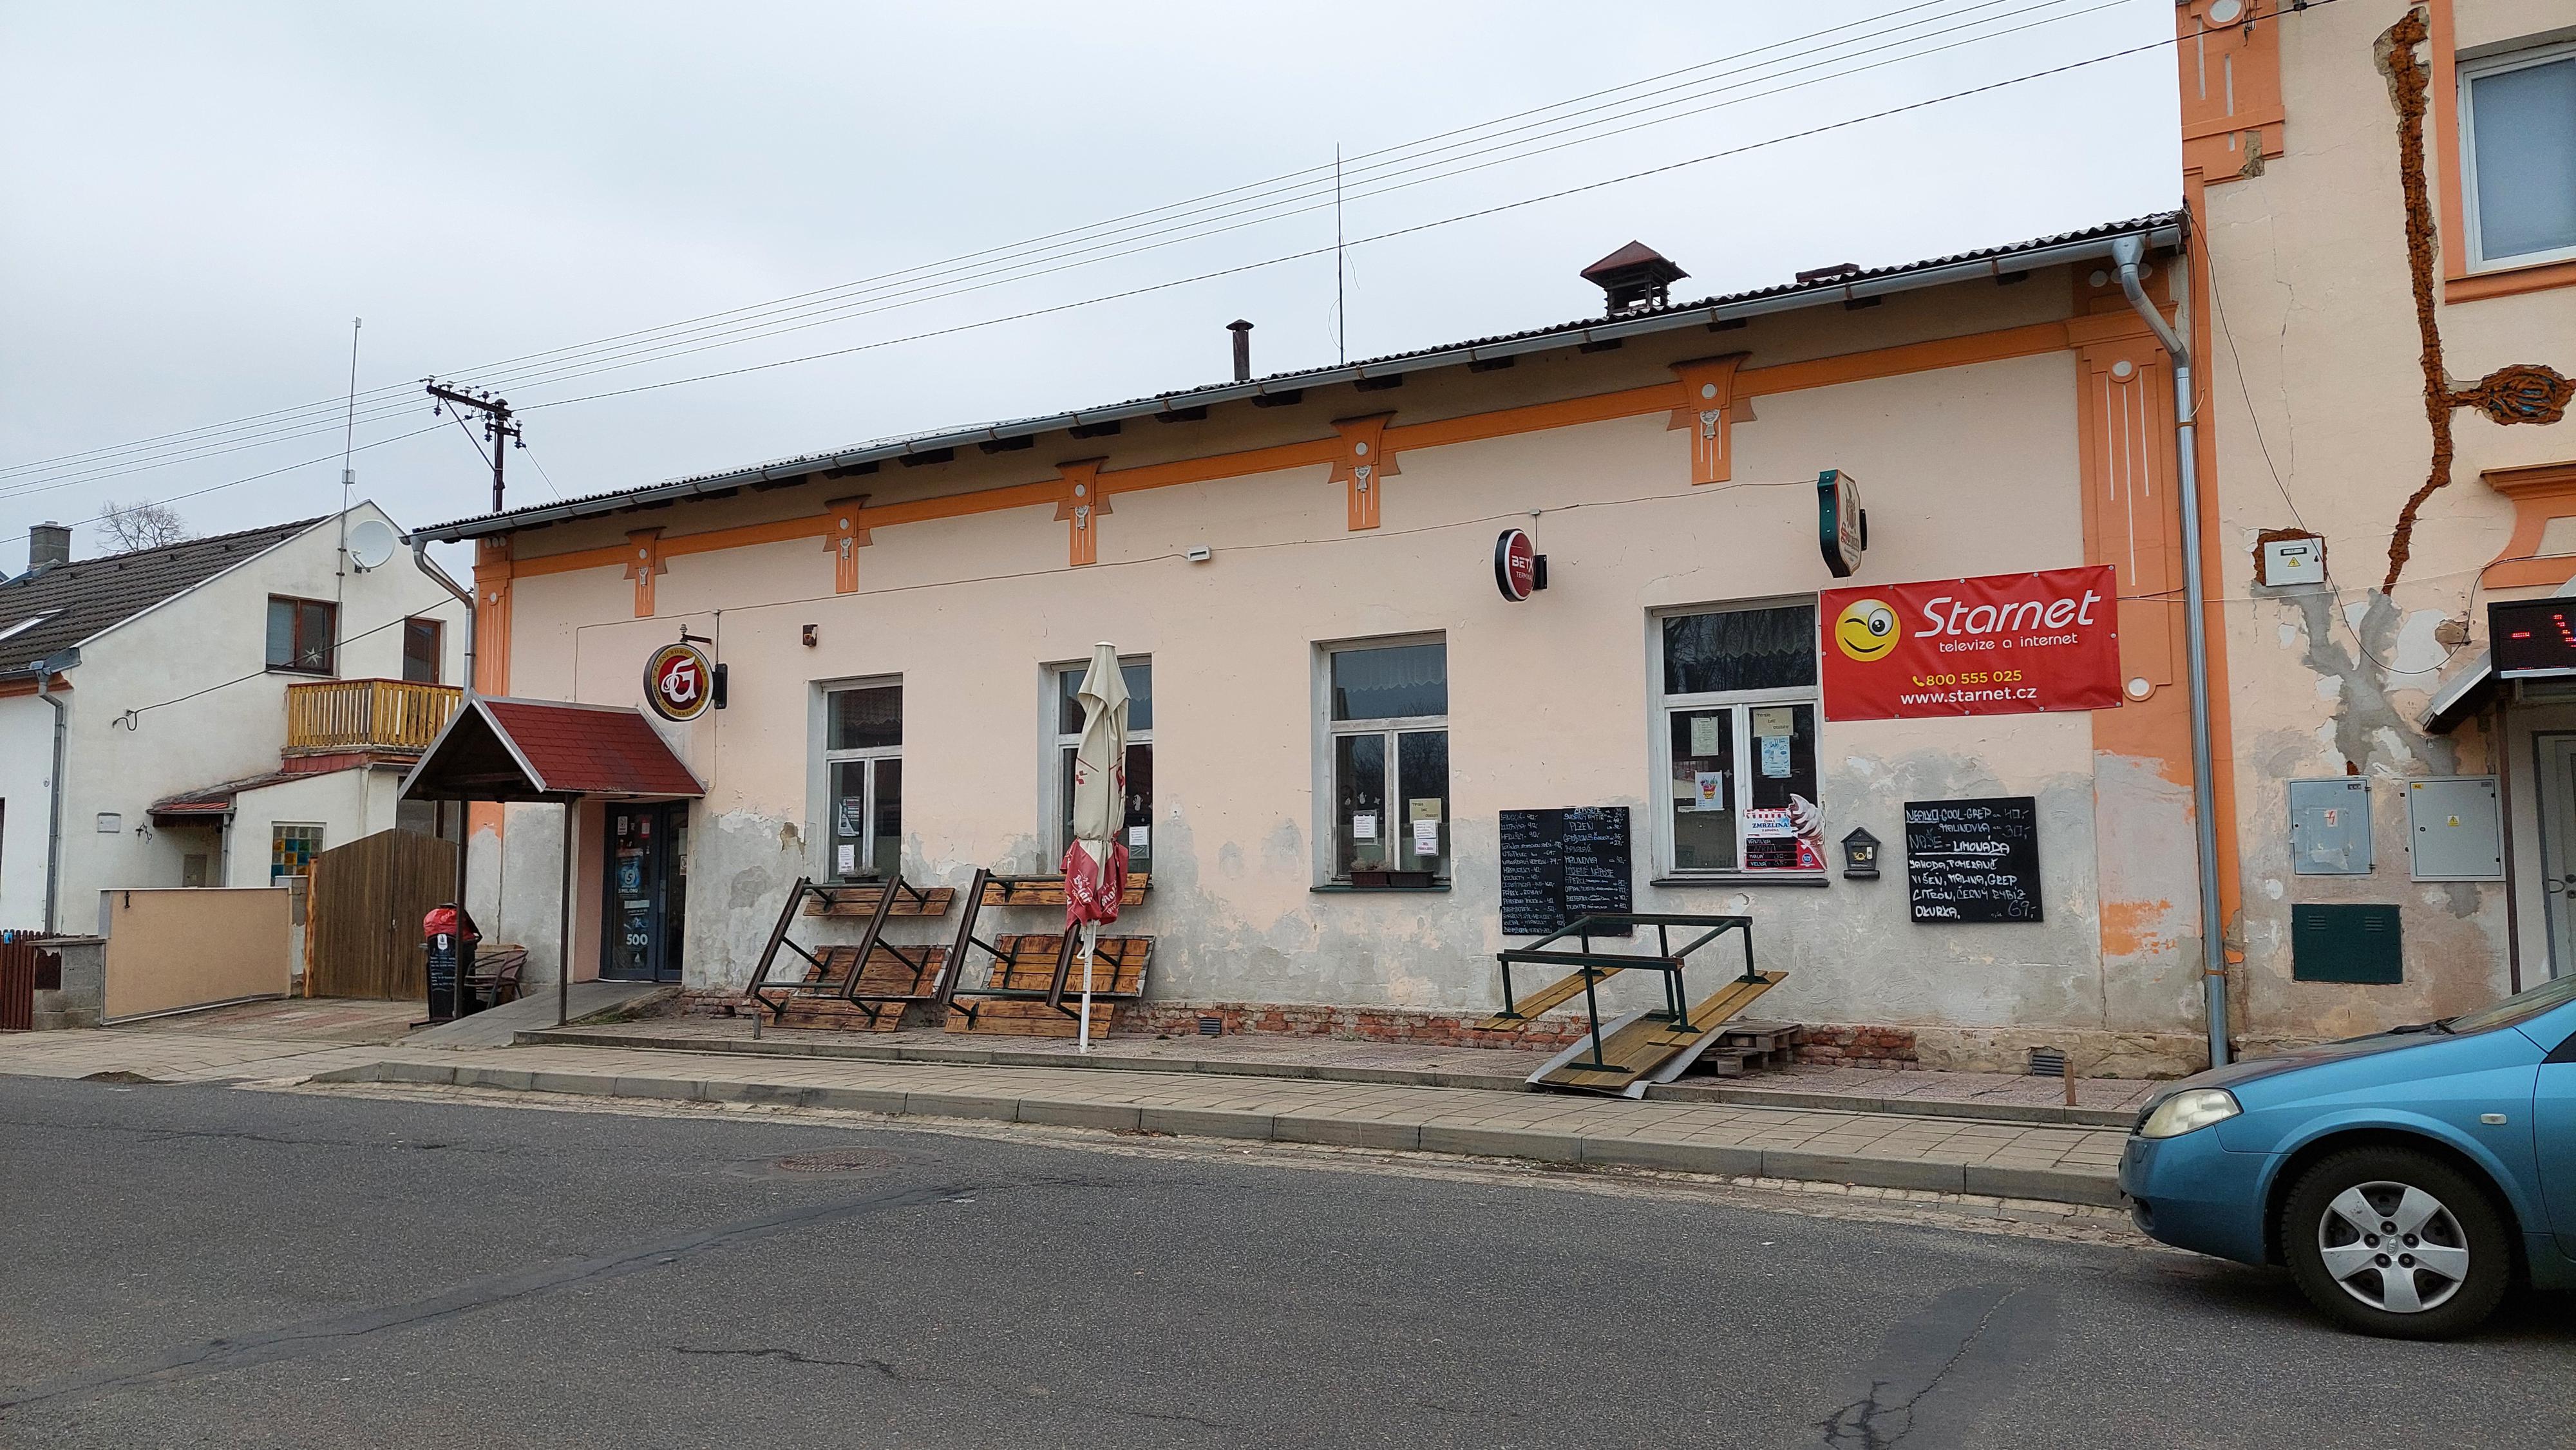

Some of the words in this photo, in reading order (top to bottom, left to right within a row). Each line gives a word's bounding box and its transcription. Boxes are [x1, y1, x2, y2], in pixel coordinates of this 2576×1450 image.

[1914, 590, 2101, 637] Starnet
[1939, 639, 1996, 652] televize
[2002, 639, 2012, 648] a
[2020, 632, 2078, 647] internet
[1926, 673, 1956, 686] 800
[1960, 672, 1988, 684] 555
[1993, 670, 2023, 683] 025
[1900, 686, 2038, 704] www.starnet.cz
[626, 933, 649, 946] 500
